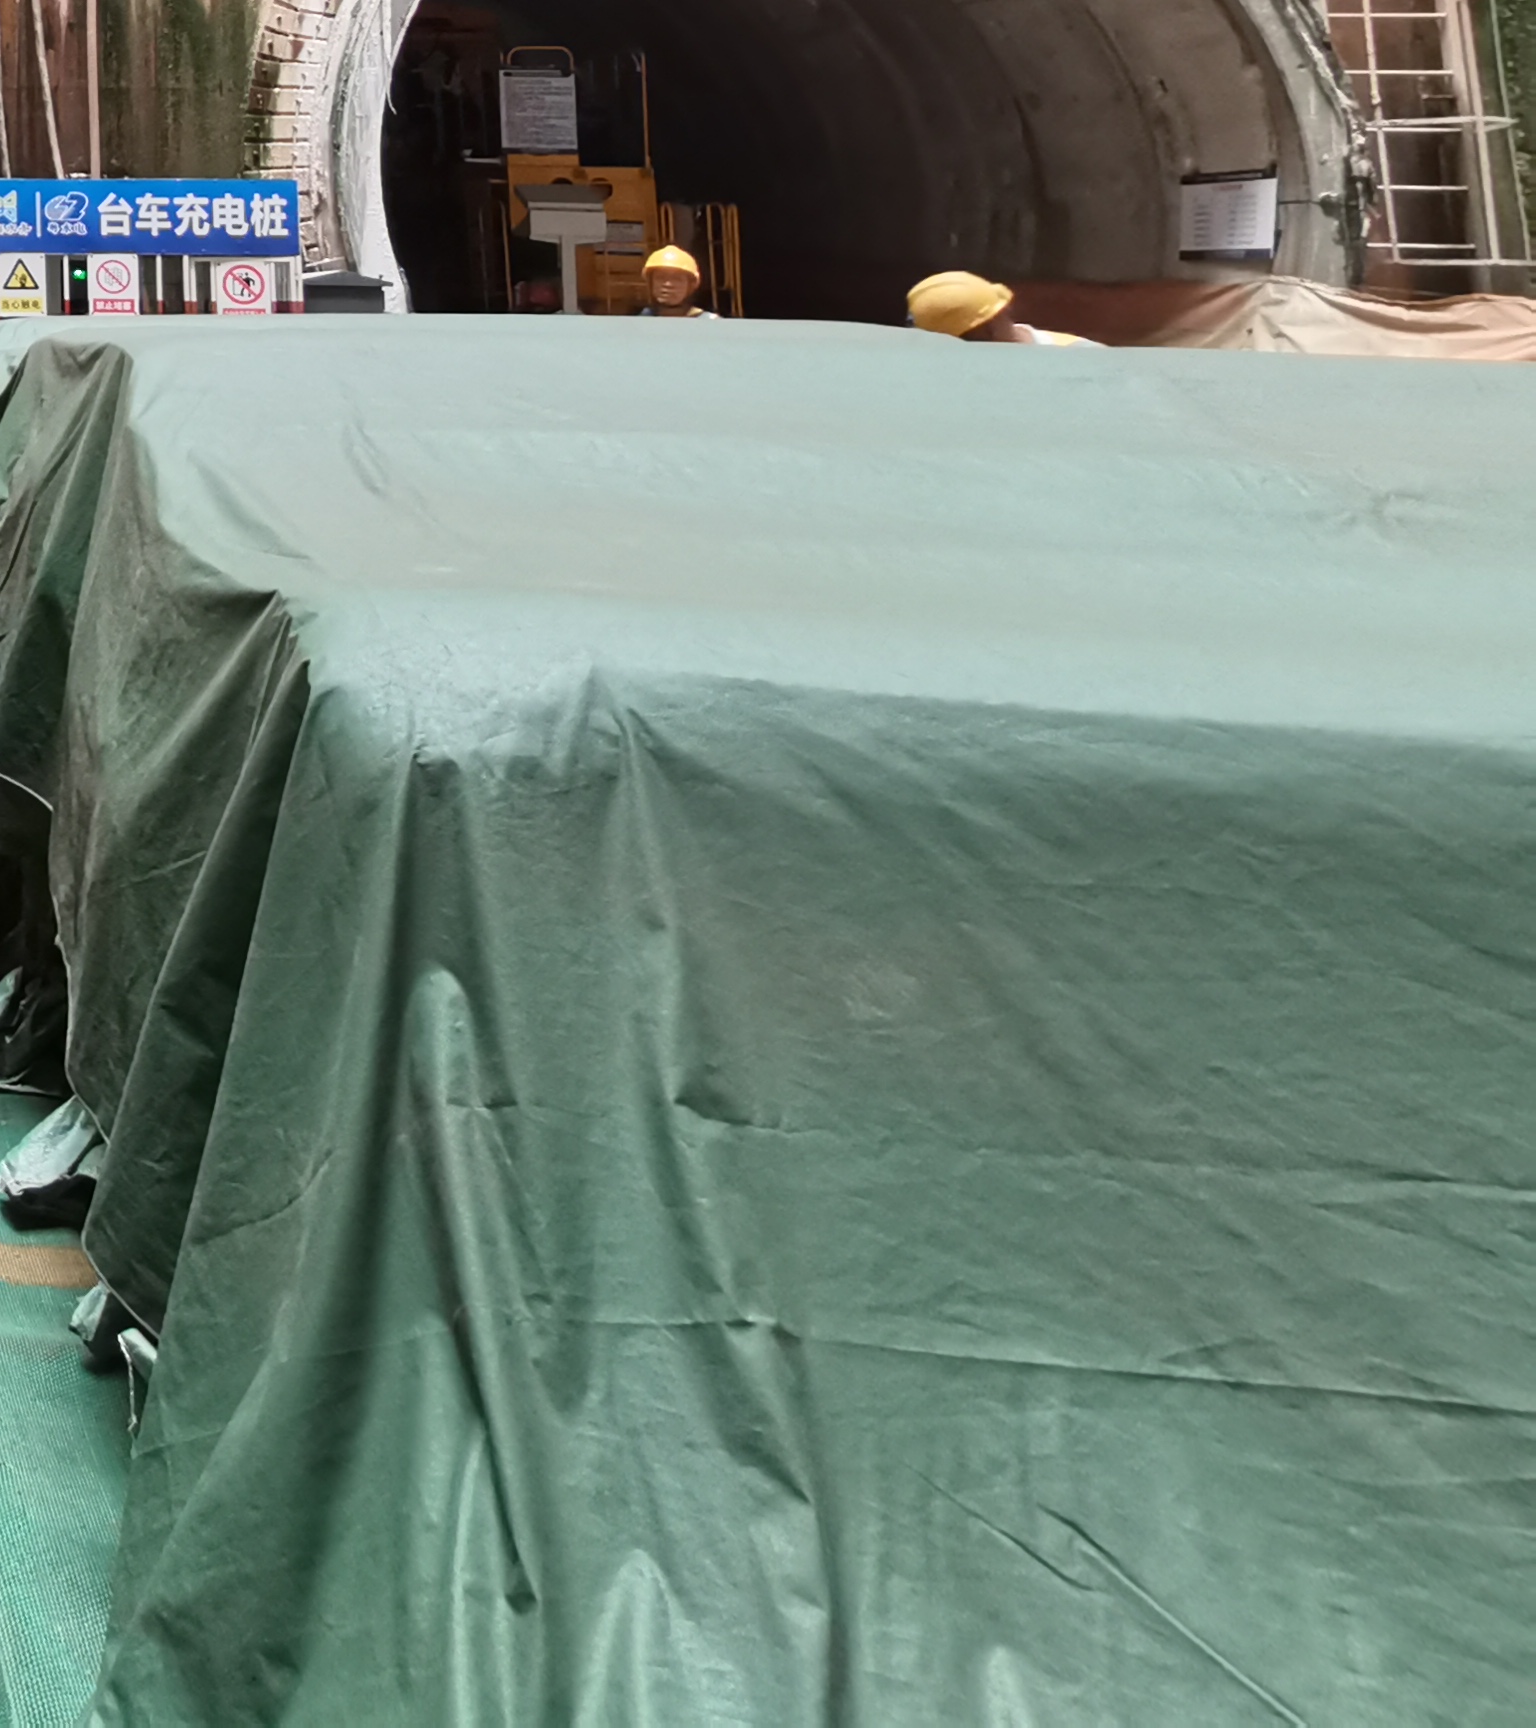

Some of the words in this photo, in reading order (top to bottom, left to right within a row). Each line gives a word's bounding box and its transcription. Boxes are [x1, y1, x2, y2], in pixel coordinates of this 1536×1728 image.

[96, 191, 290, 238] 台车充电桩
